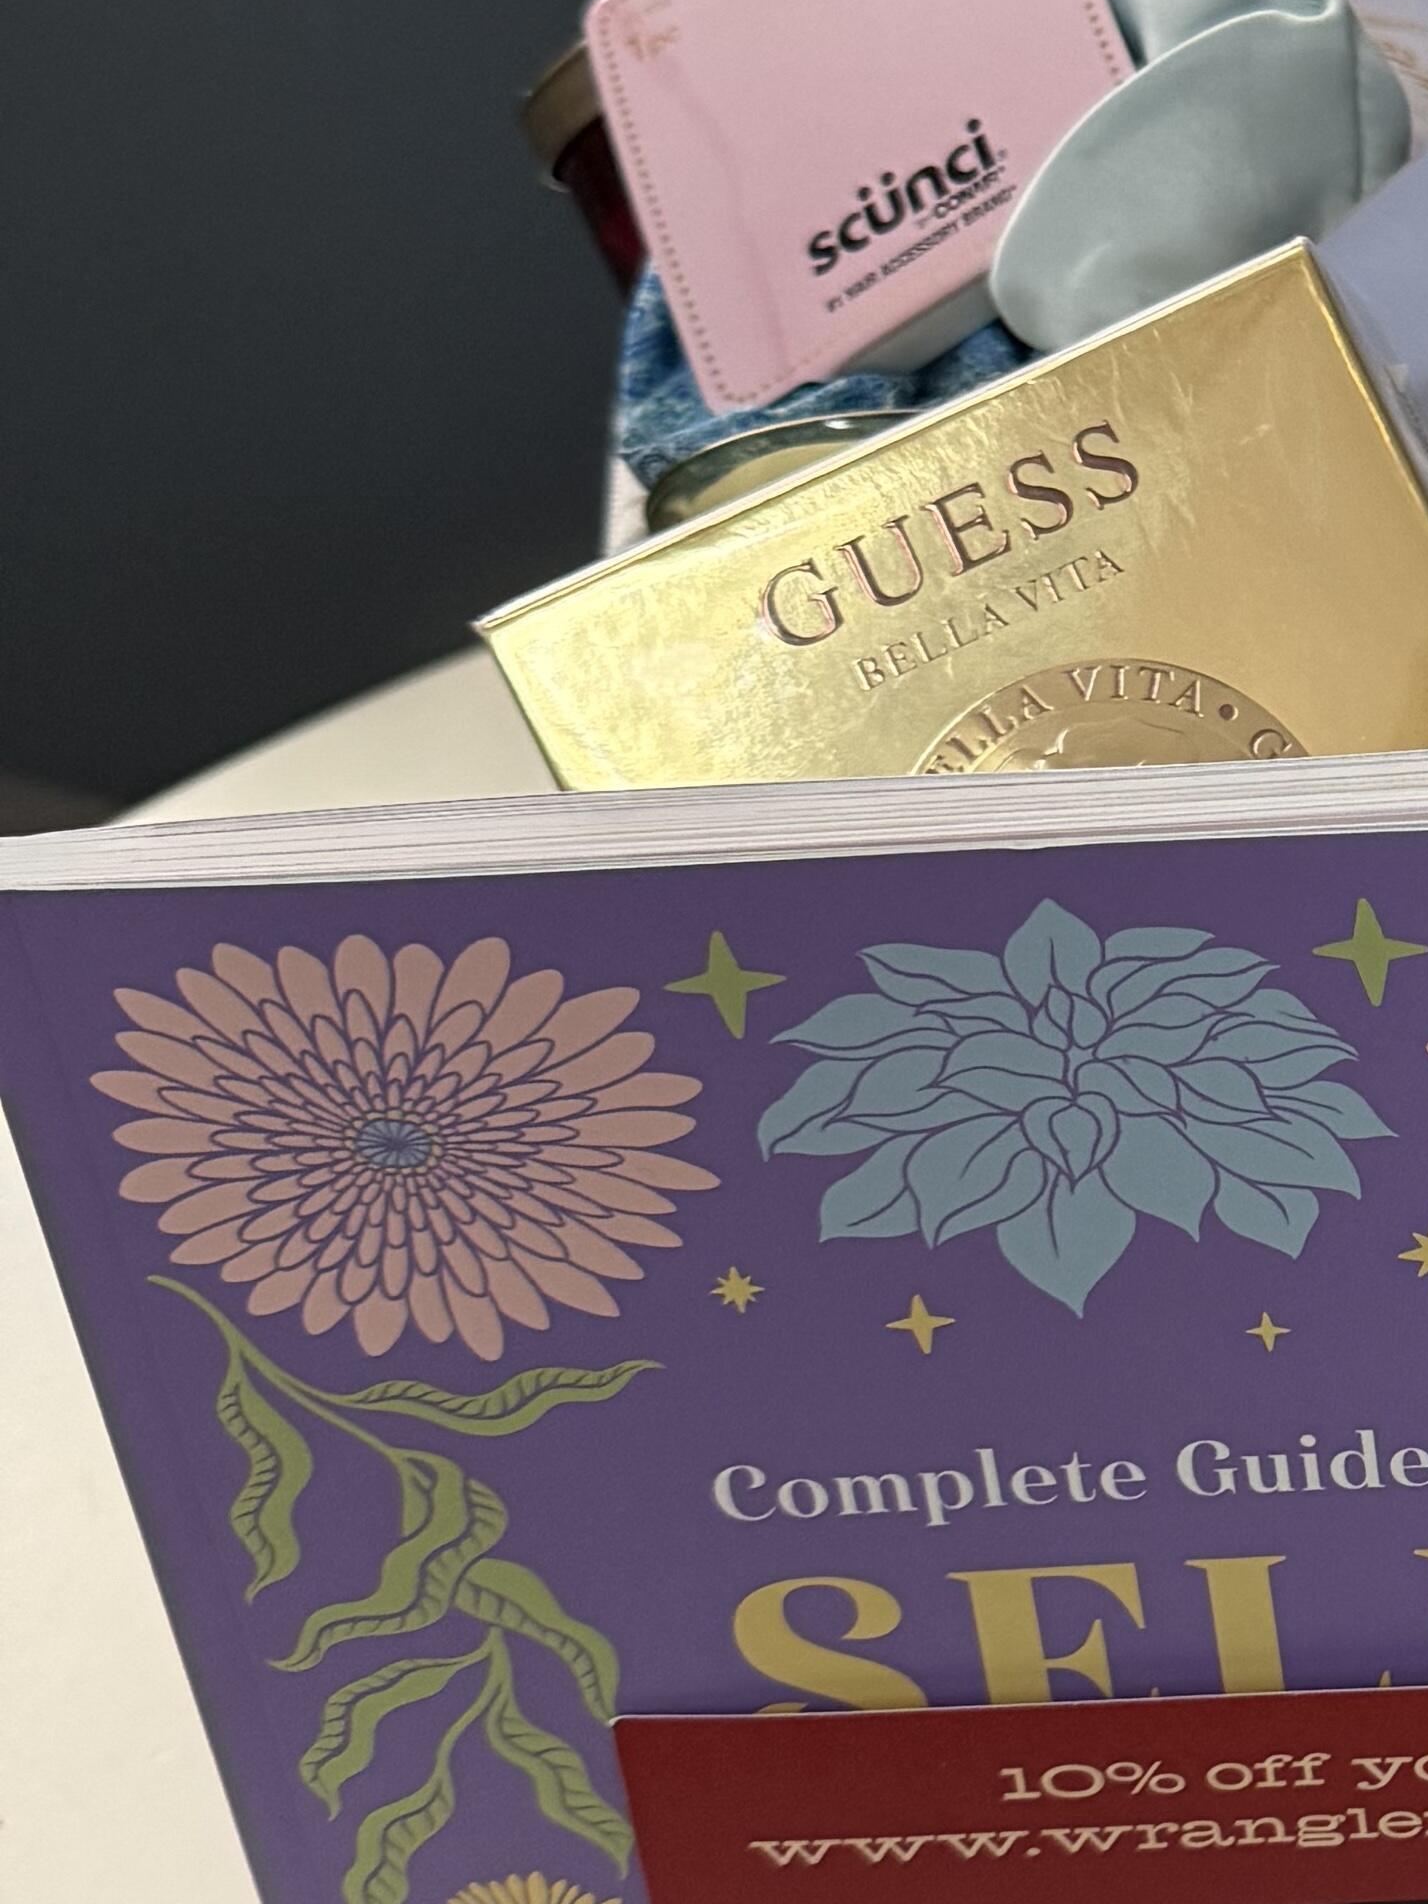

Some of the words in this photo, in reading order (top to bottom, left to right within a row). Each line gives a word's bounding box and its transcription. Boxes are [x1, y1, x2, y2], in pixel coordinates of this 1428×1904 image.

[760, 418, 1141, 648] GUESS
[854, 601, 1010, 693] BELLA
[1014, 549, 1125, 607] VITA
[1063, 663, 1206, 720] VITA
[710, 1427, 1150, 1528] Complete
[999, 1760, 1187, 1803] 10%
[1205, 1751, 1332, 1793] off
